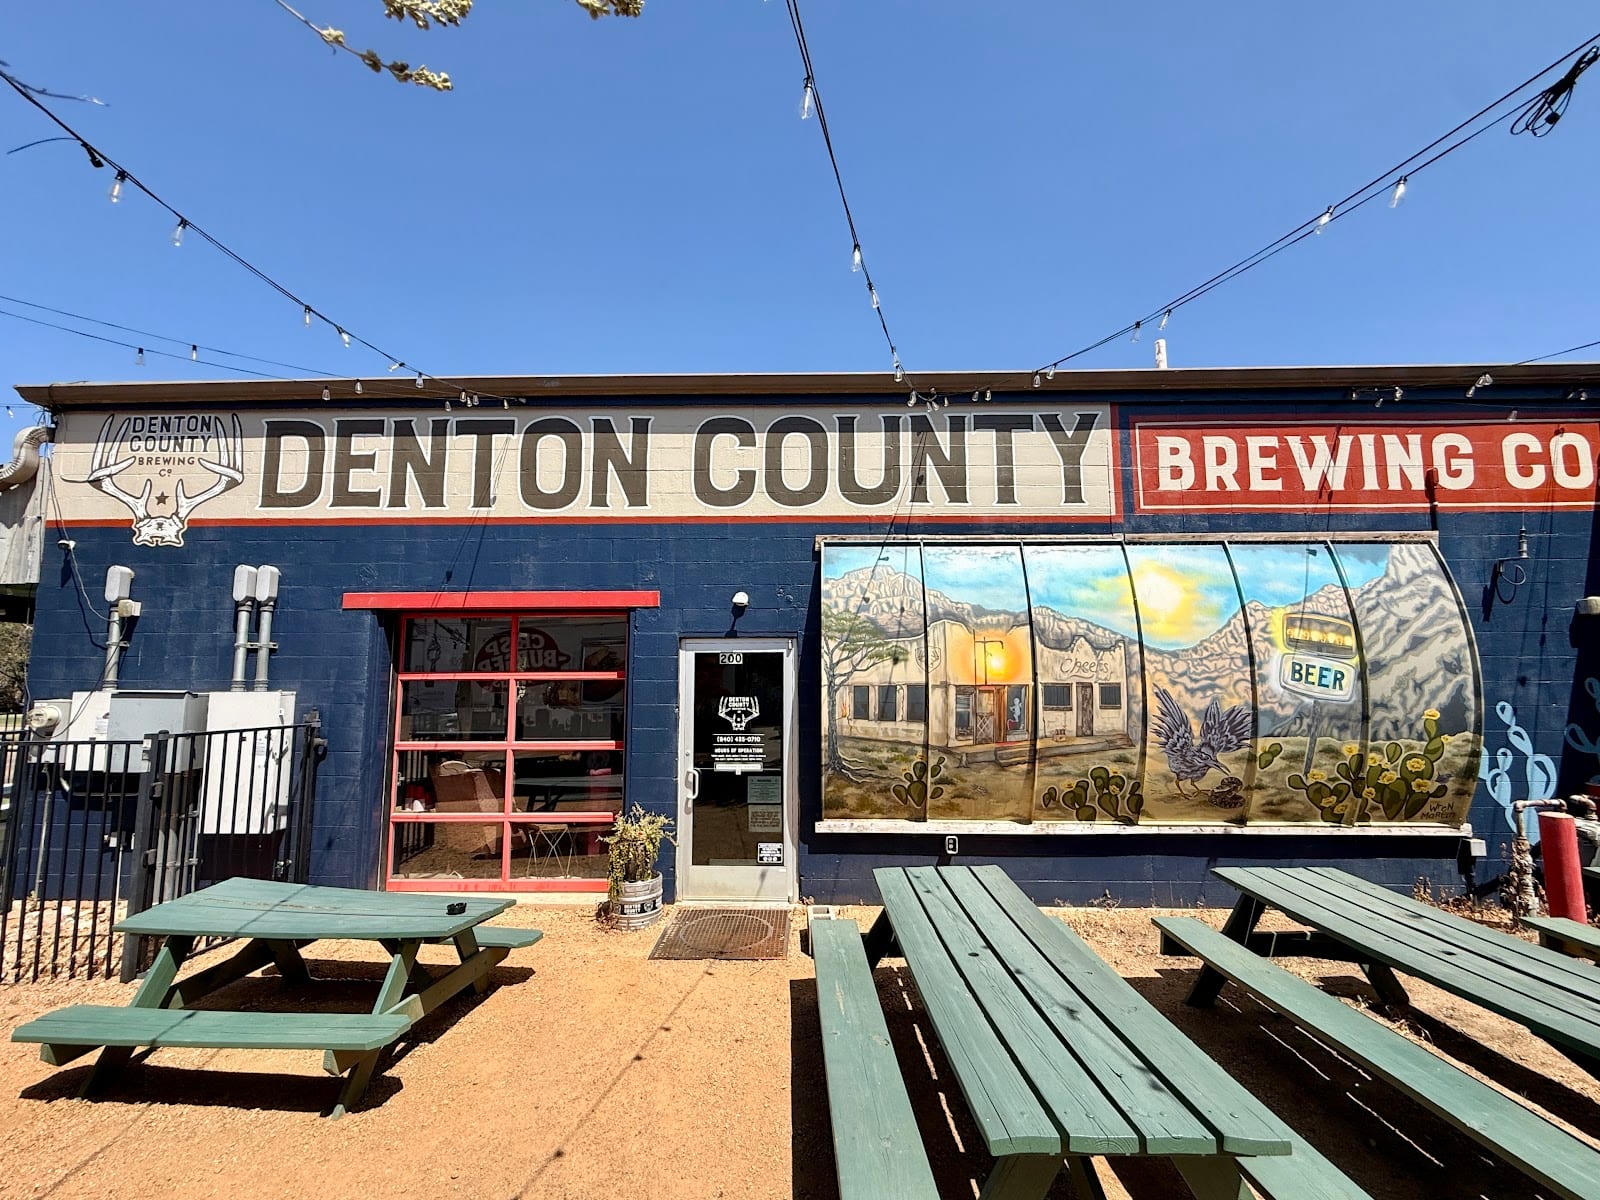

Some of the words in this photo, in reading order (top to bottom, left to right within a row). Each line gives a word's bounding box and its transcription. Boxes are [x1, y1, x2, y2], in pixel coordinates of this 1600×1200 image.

[131, 415, 213, 434] DENTON
[129, 435, 212, 453] COUNTY
[138, 456, 195, 466] BREWING
[255, 416, 654, 512] DENTON
[692, 412, 1102, 509] COUNTY
[1155, 432, 1475, 491] BREWING
[1501, 432, 1594, 490] CO
[720, 653, 742, 664] 200
[1060, 657, 1109, 674] Cheers
[1290, 661, 1345, 691] BEER
